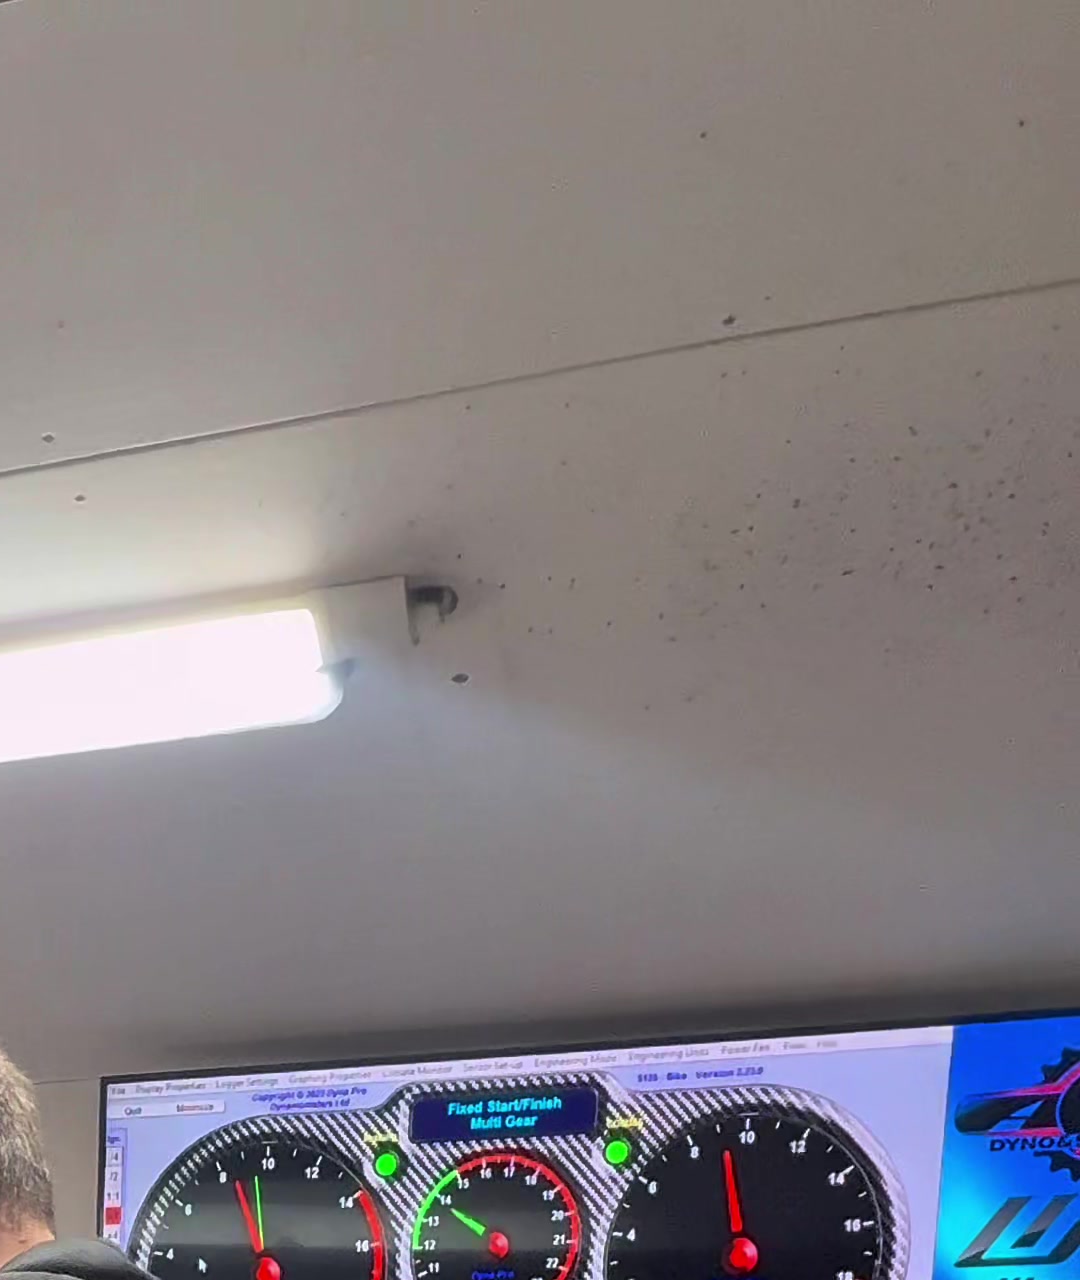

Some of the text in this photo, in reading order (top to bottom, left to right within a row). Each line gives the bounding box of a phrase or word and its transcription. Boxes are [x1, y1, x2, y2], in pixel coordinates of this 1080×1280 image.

[448, 1095, 562, 1116] Fixed Start/Finish
[470, 1114, 539, 1130] Multi Gear
[738, 1131, 756, 1145] 10
[689, 1146, 700, 1160] 8
[788, 1140, 807, 1154] 12
[261, 1158, 276, 1170] 10
[304, 1166, 320, 1180] 12
[503, 1167, 516, 1179] 17
[827, 1172, 846, 1186] 14
[457, 1177, 470, 1189] 15
[338, 1196, 355, 1209] 14
[439, 1194, 452, 1206] 14
[184, 1203, 193, 1217] 6
[550, 1209, 565, 1222] 20
[427, 1215, 440, 1228] 13
[843, 1219, 862, 1232] 16
[552, 1234, 566, 1246] 21
[625, 1229, 637, 1242] 4
[423, 1239, 437, 1251] 12
[165, 1248, 175, 1261] 4
[428, 1262, 440, 1274] 11
[545, 1257, 560, 1269] 22
